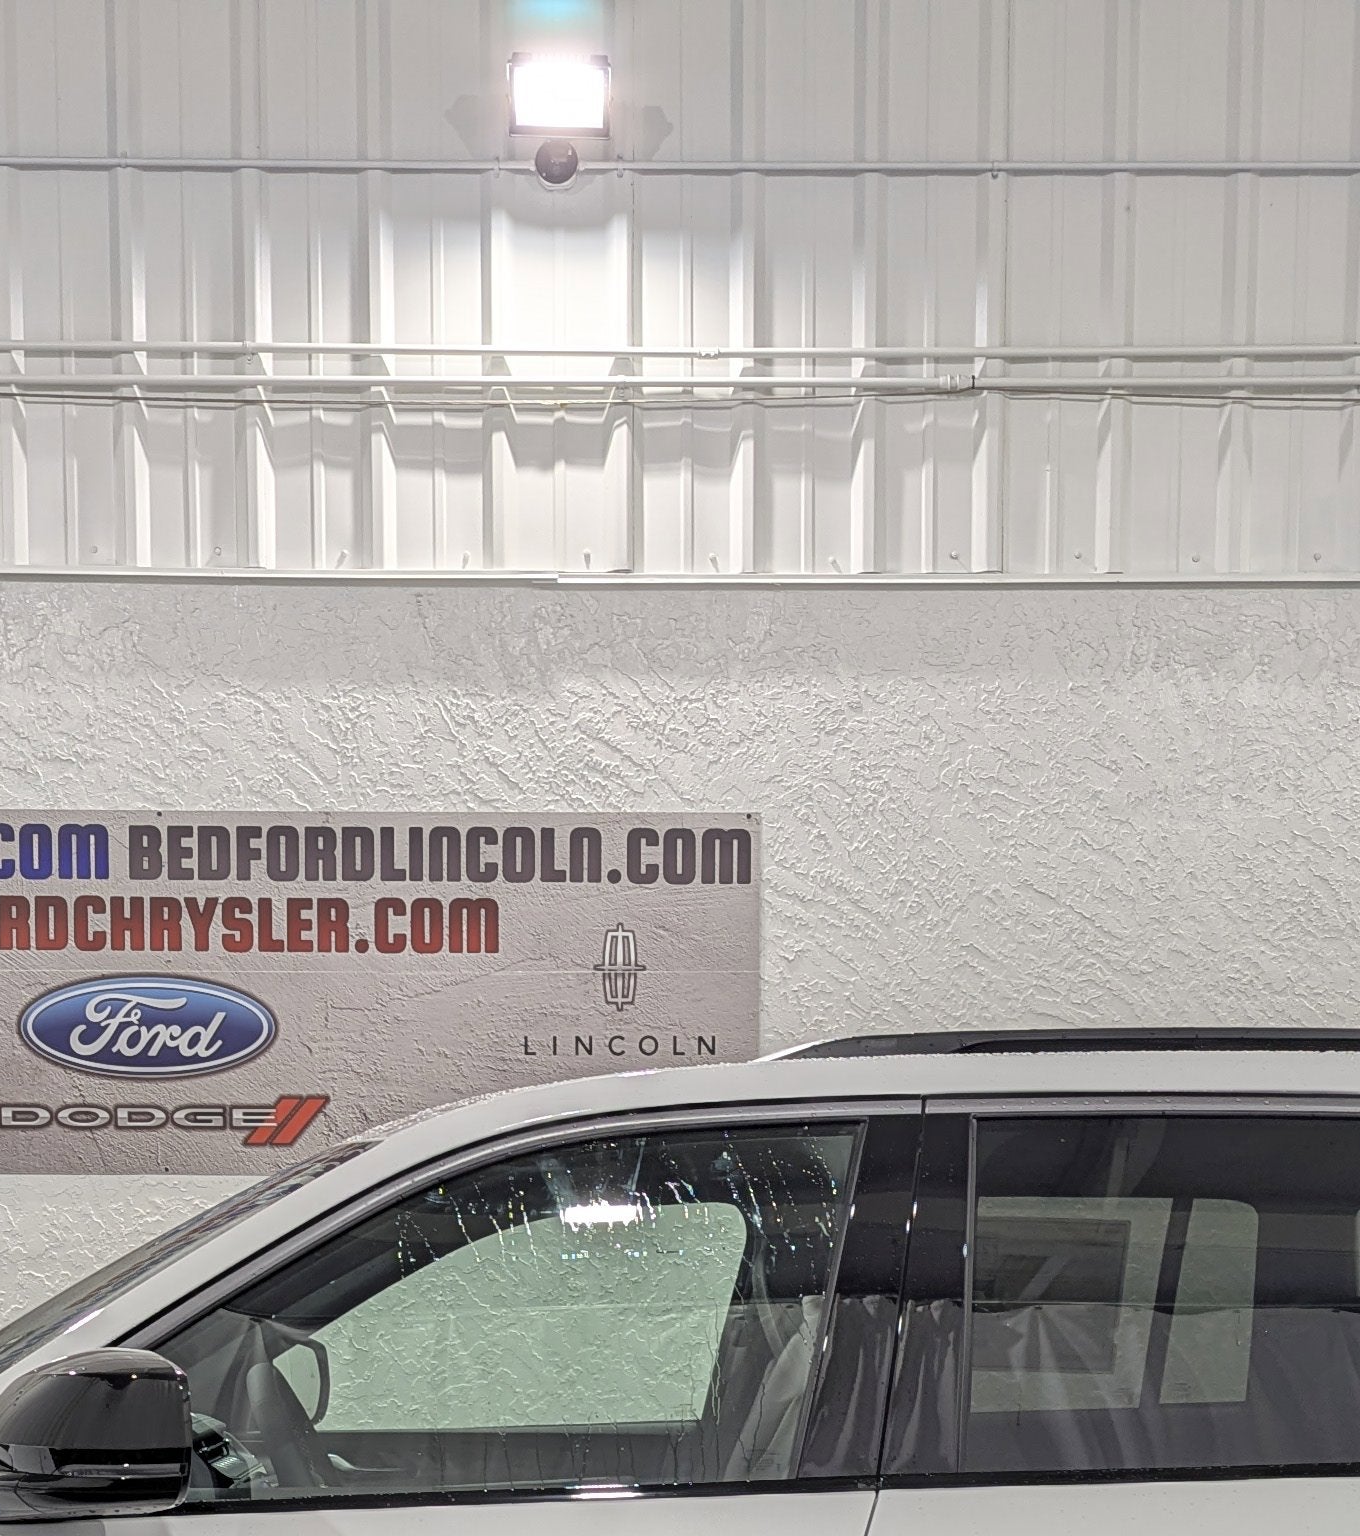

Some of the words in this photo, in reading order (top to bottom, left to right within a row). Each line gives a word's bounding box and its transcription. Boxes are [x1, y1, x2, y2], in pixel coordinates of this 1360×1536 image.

[127, 824, 754, 885] BEDFORDLINCOLN.COM
[69, 993, 228, 1058] Ford
[524, 1035, 716, 1057] LINCOLN
